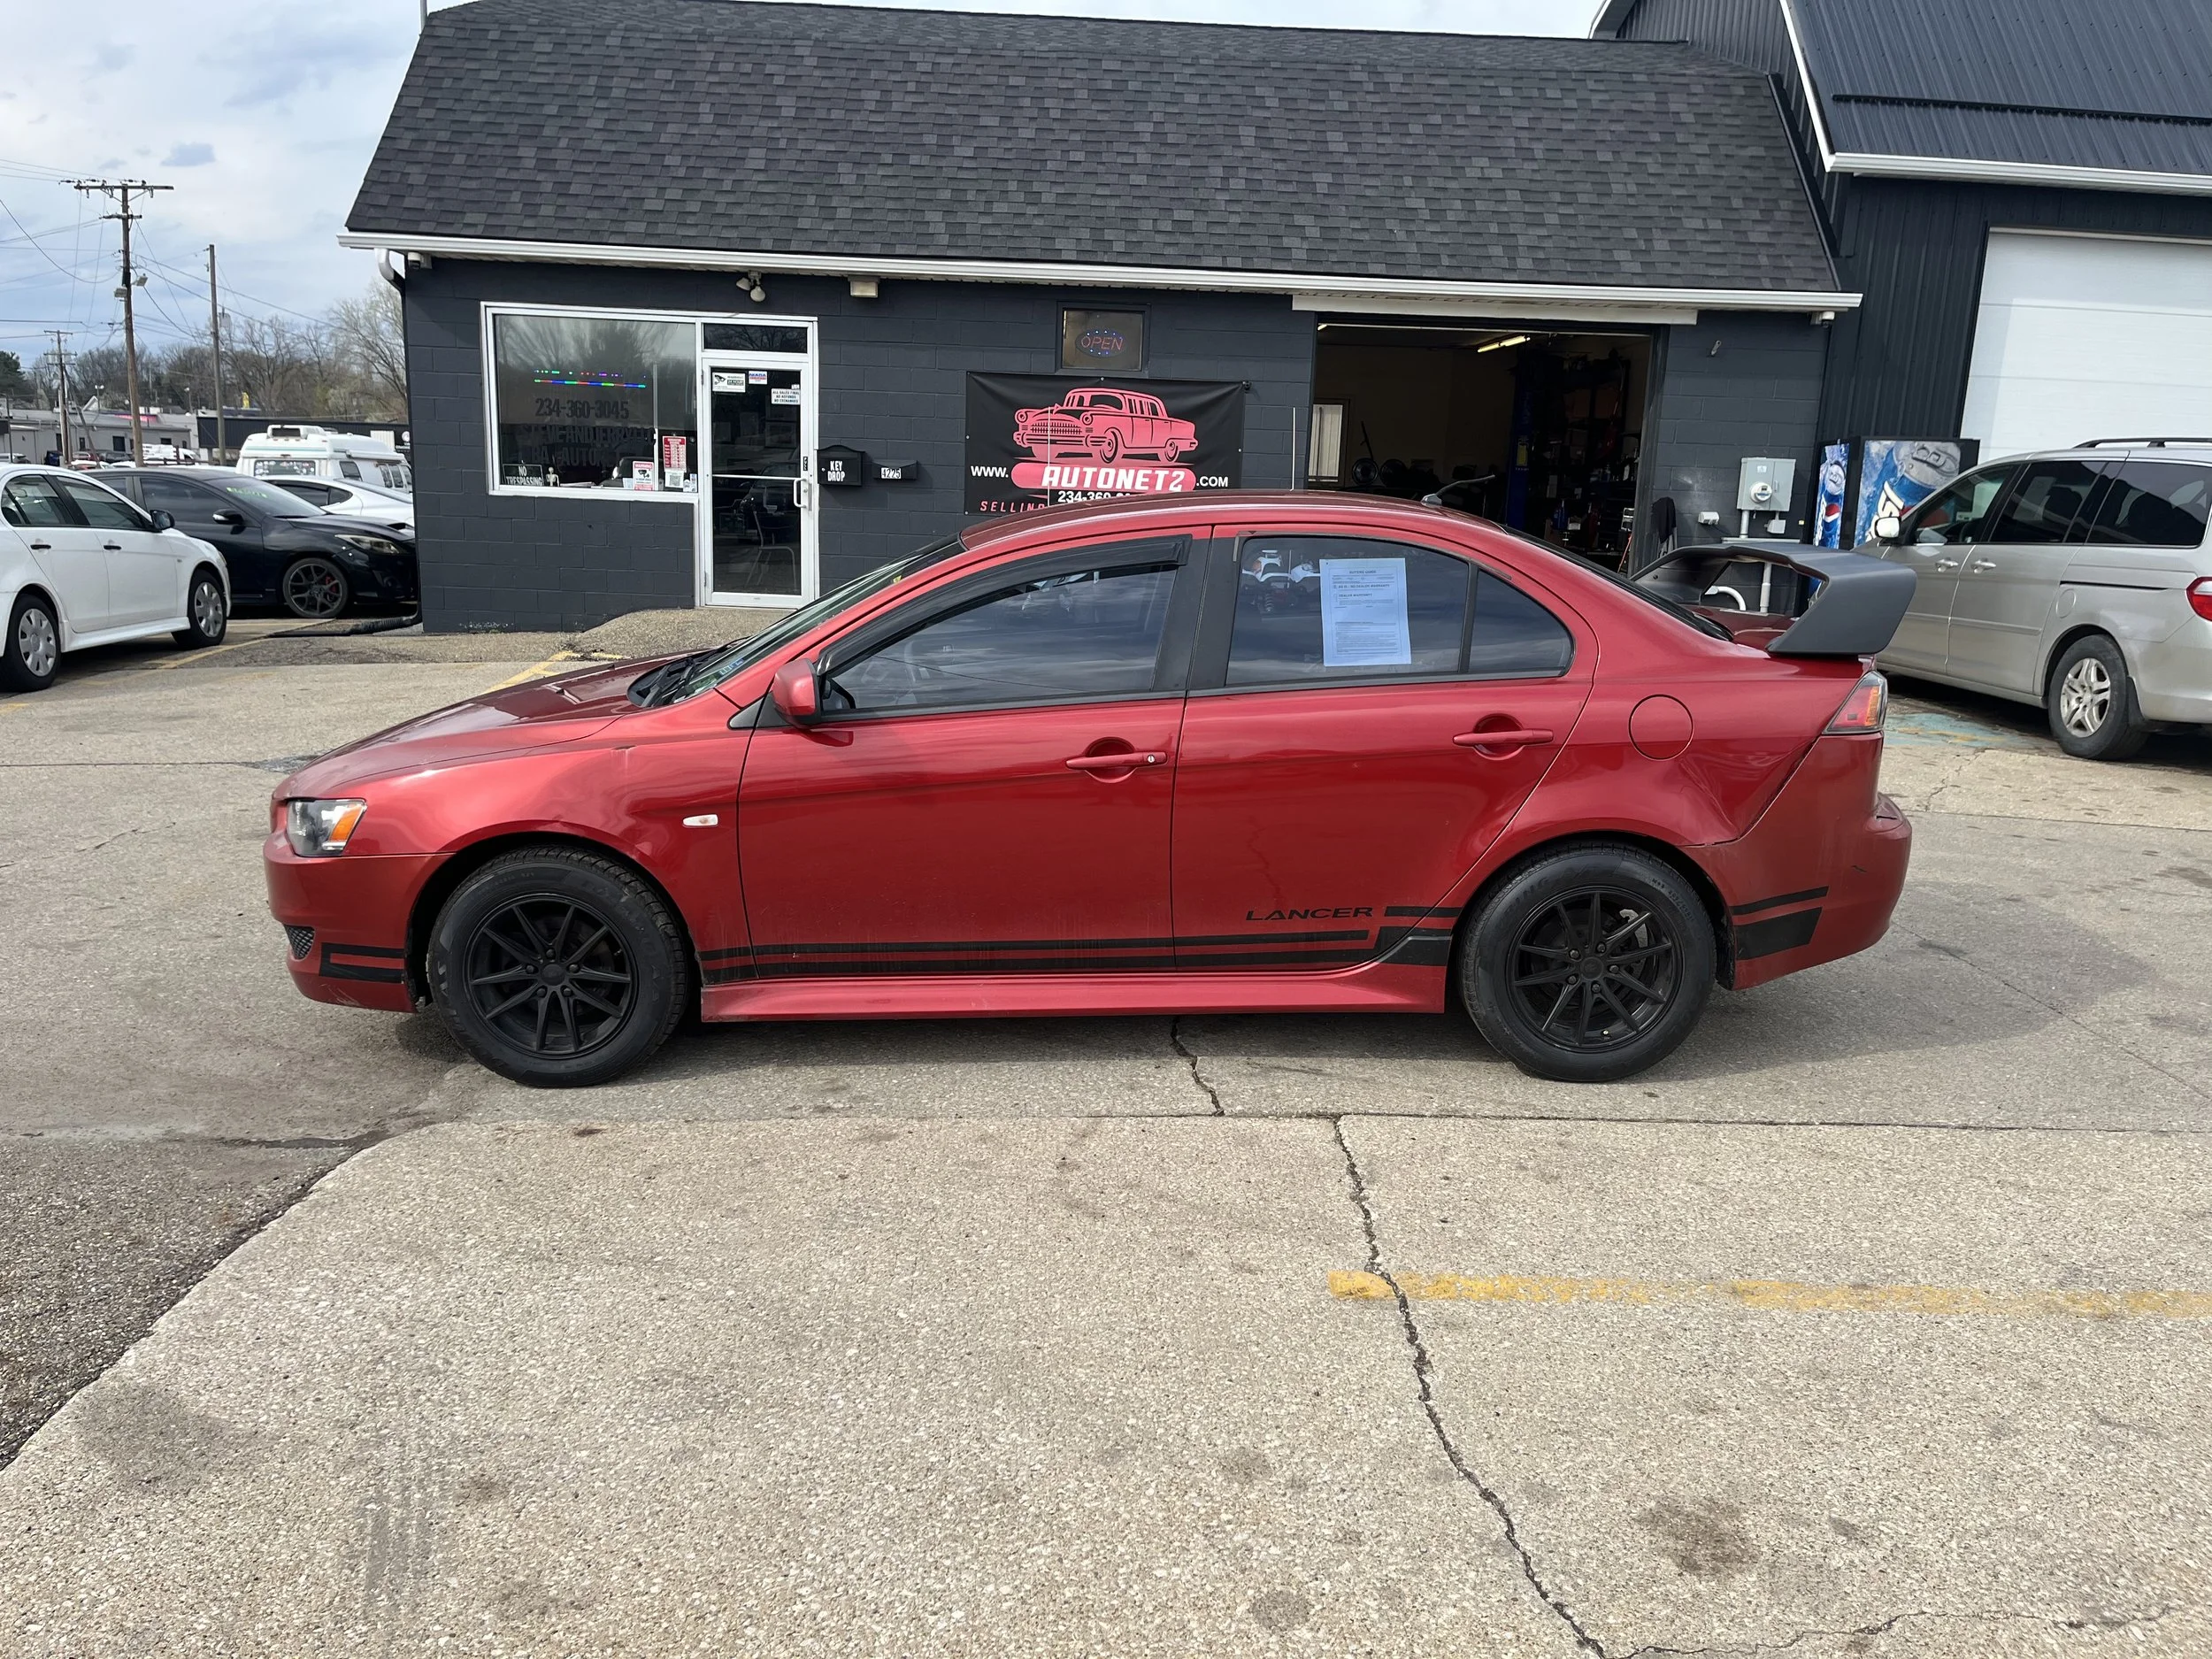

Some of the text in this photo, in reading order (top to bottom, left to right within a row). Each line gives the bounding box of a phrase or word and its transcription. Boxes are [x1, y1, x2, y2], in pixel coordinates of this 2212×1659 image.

[1080, 334, 1123, 351] OPEN
[535, 398, 630, 419] 234-360-3045
[518, 465, 527, 477] NO
[830, 460, 843, 471] KEY
[827, 471, 846, 482] DROP
[881, 467, 902, 479] 4225
[1041, 465, 1186, 493] AUTONET2
[1196, 475, 1229, 488] .COM
[505, 476, 543, 486] TRESPASSING
[1246, 907, 1373, 921] LANCER
